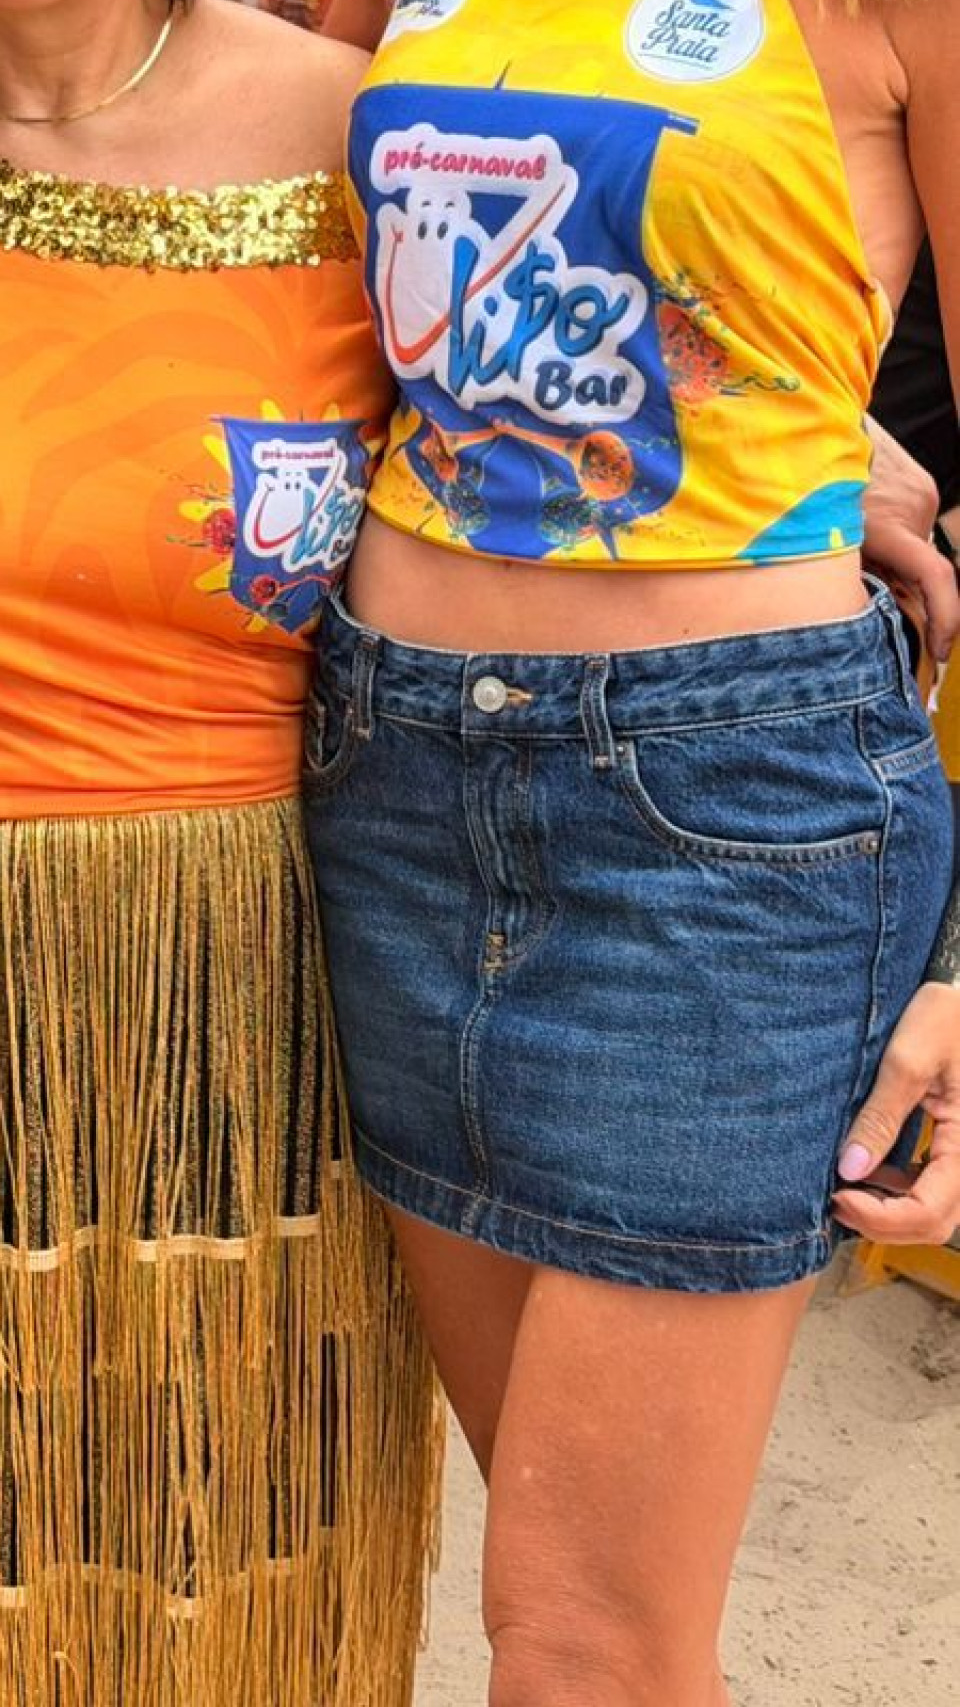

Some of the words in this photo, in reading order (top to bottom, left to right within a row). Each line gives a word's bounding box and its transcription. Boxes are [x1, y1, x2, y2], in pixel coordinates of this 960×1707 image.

[641, 21, 719, 62] Praia
[384, 141, 547, 180] pré-carnaval
[534, 360, 628, 410] Bar
